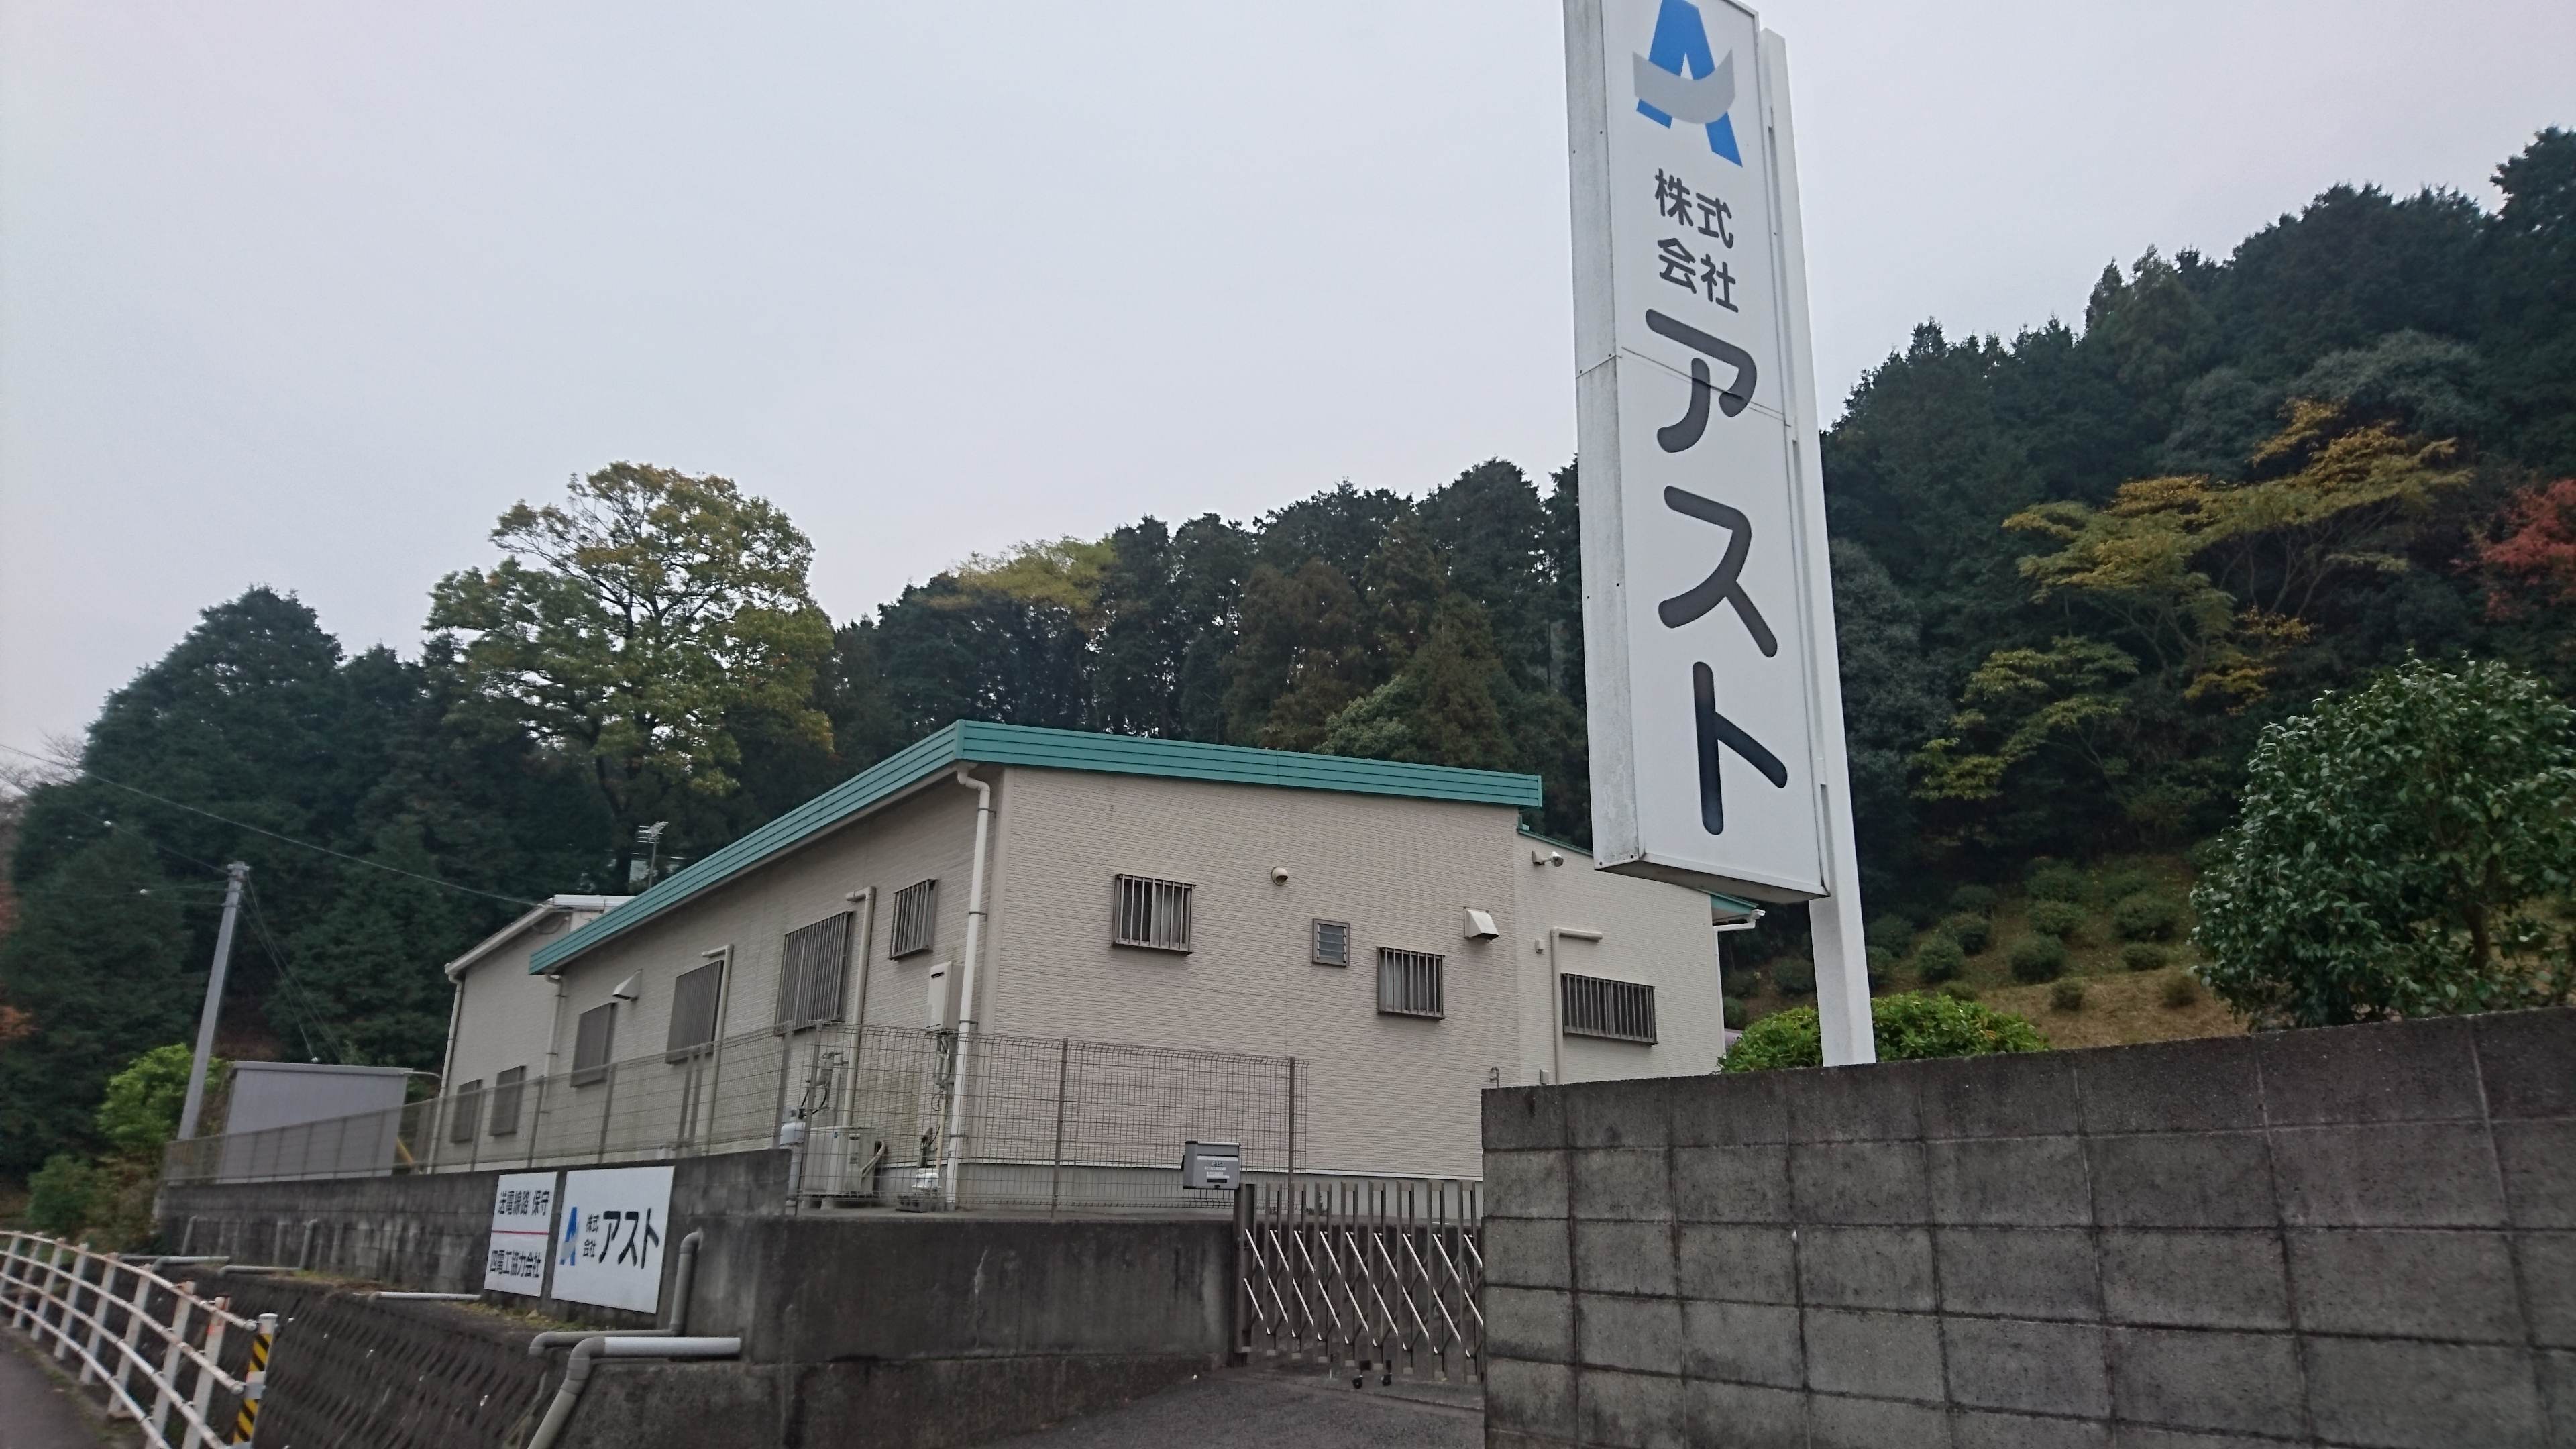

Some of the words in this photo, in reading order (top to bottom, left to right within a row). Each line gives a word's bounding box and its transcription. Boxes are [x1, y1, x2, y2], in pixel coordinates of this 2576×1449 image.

[1654, 168, 1734, 249] 株式
[1657, 237, 1739, 313] 会社
[1645, 309, 1788, 835] アスト
[531, 1190, 550, 1216] 保守
[586, 1214, 600, 1233] 株式
[582, 1238, 596, 1258] 会社
[598, 1208, 659, 1269] アスト
